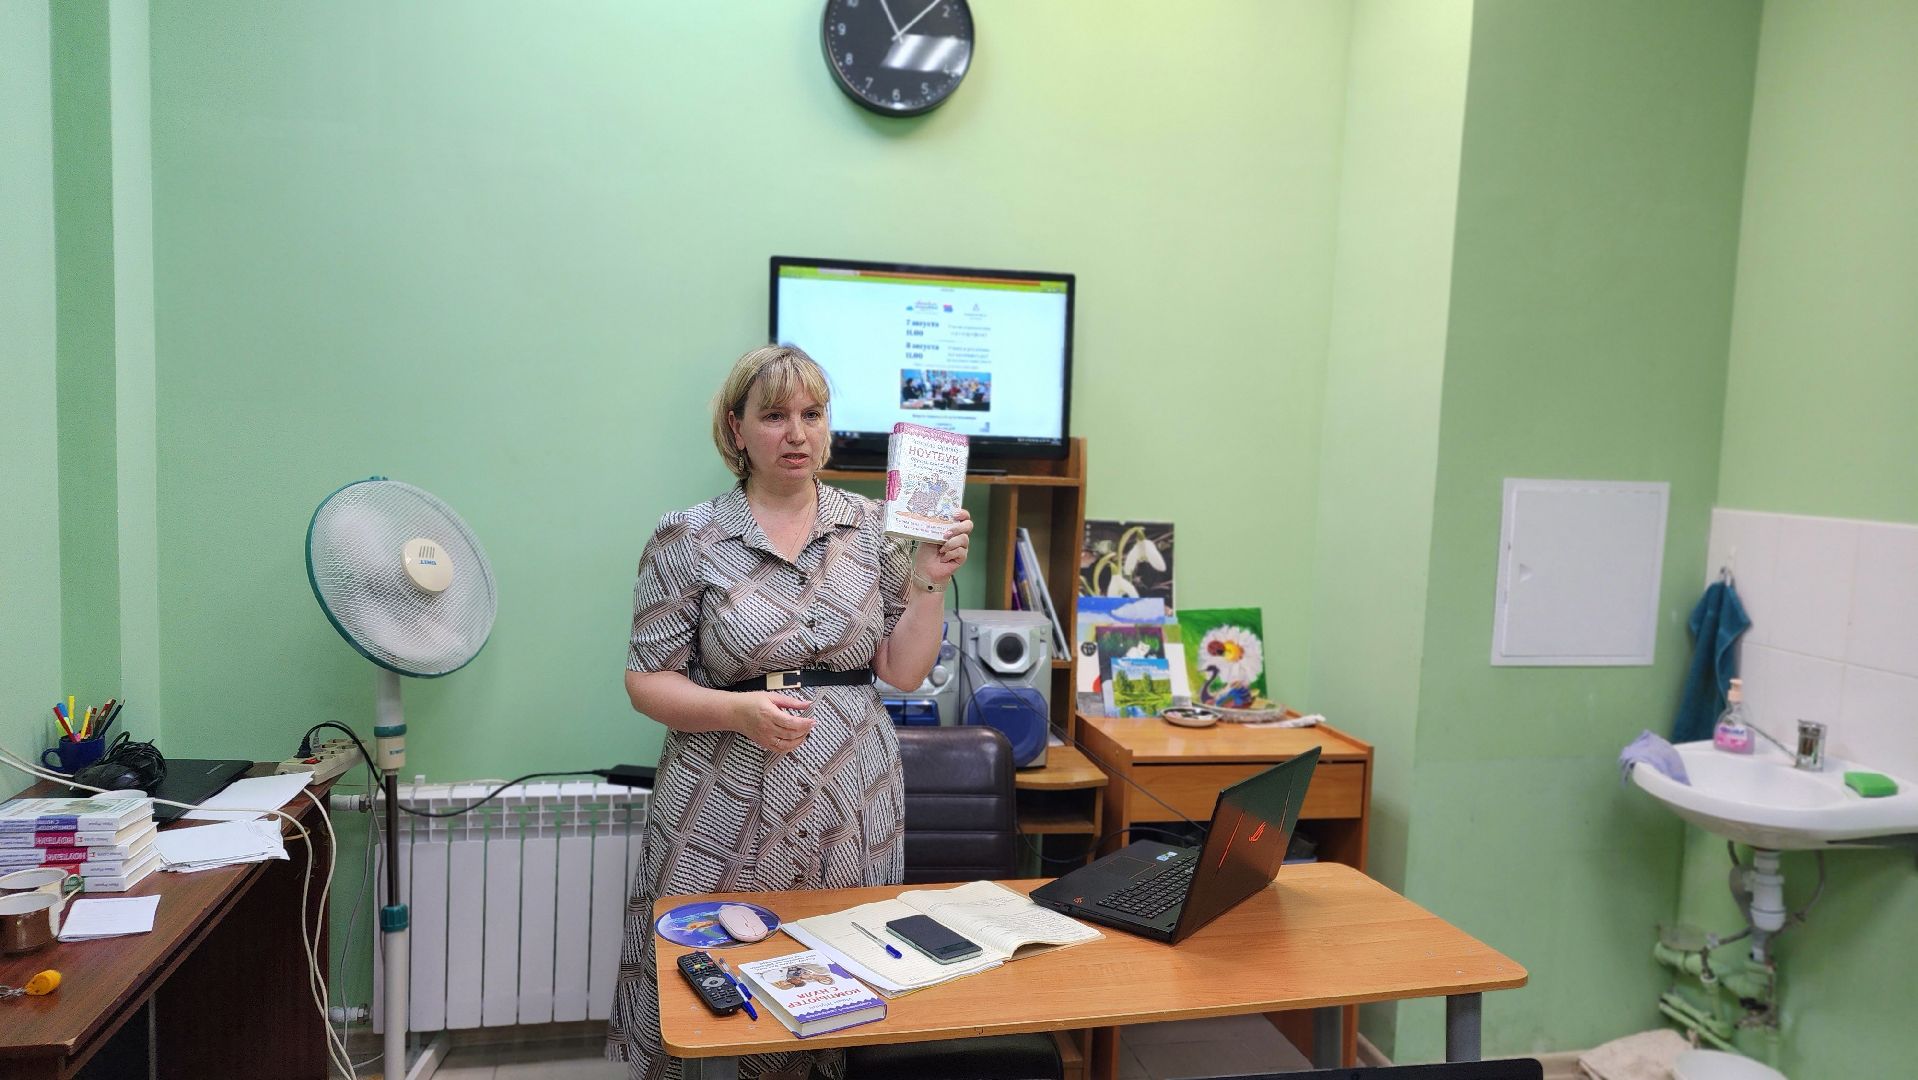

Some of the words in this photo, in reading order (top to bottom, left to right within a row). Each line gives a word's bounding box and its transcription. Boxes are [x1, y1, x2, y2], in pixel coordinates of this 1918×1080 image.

[942, 6, 951, 18] 2
[837, 23, 846, 35] 9
[845, 53, 853, 65] 8
[865, 77, 873, 89] 7
[921, 83, 929, 94] 5
[892, 89, 900, 100] 6
[787, 988, 863, 1009] КОМПЬЮТЕР
[796, 987, 831, 999] НУЛЯ
